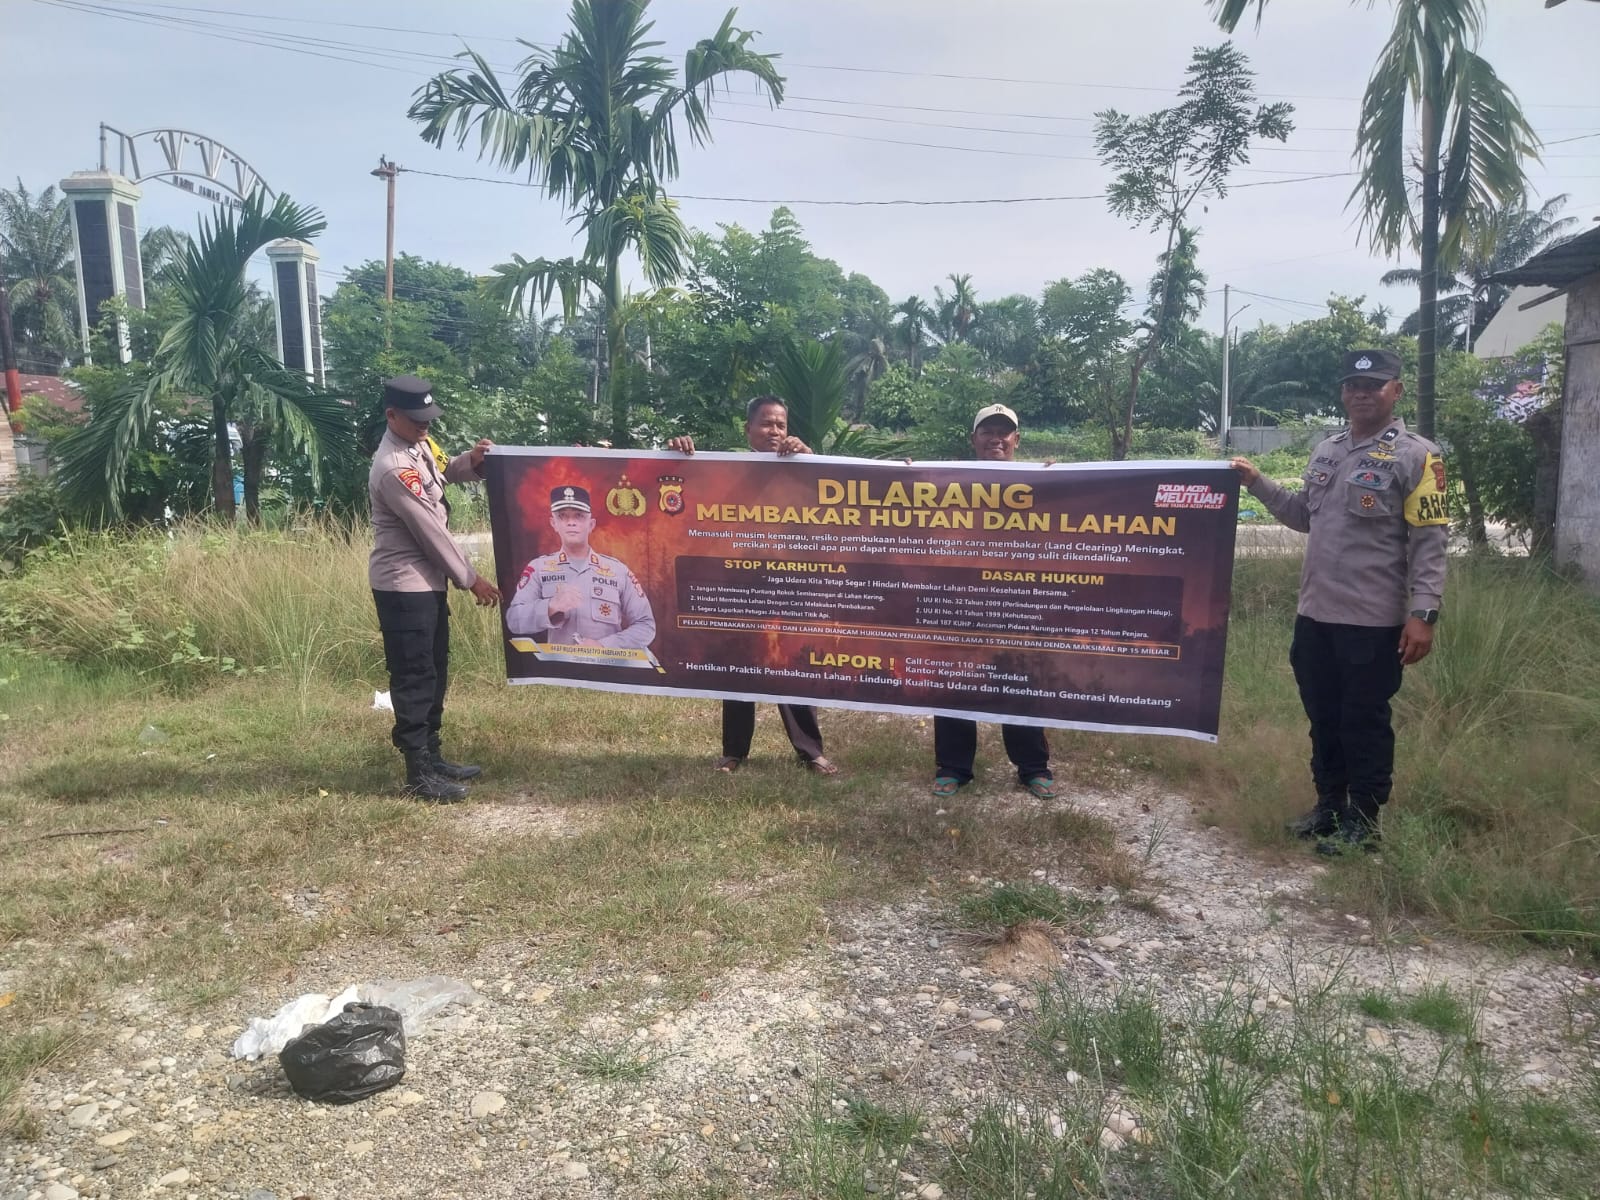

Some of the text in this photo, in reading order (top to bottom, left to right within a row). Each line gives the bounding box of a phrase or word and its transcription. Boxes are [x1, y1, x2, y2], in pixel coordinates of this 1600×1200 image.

[1359, 459, 1394, 470] POLRI
[818, 478, 1034, 510] DILARANG
[1157, 484, 1208, 493] POLDA ACEH
[1154, 492, 1225, 504] MEUTUAH
[696, 503, 1177, 536] MEMBAKAR HUTAN DAN LAHAN
[688, 528, 733, 538] Memasuki
[736, 530, 764, 539] musim
[767, 531, 808, 543] kemarau,
[811, 533, 838, 542] resiko
[841, 534, 895, 545] pembukaan
[898, 535, 923, 544] lahan
[926, 536, 961, 547] dengan
[987, 538, 1040, 549] membakar
[1044, 541, 1071, 552] (Land
[1075, 542, 1121, 554] Clearing)
[1125, 544, 1184, 556] Meningkat,
[732, 539, 1131, 562] percikan api sekecil apa pun dapat memicu kebakaran besar yang sulit dikendalikan.
[724, 559, 847, 574] STOP KARHUTLA
[541, 575, 565, 583] MUGHI
[592, 577, 617, 587] POLRI
[981, 570, 1104, 585] DASAR HUKUM
[767, 575, 783, 584] Jaga
[785, 575, 806, 583] Udara
[824, 577, 843, 587] Tetap
[845, 578, 866, 588] Segar
[872, 580, 899, 588] Hindari
[901, 581, 941, 590] Membakar
[943, 584, 966, 592] Lahan
[967, 585, 988, 593] Demi
[990, 586, 1030, 595] Kesehatan
[1032, 588, 1068, 597] Bersama.
[942, 607, 953, 615] No.
[1002, 600, 1047, 610] (Perlindungan
[1063, 603, 1103, 613] Pengelolaan
[1105, 605, 1145, 615] Lingkungan
[1147, 608, 1172, 617] Hidup).
[922, 617, 939, 625] Pasal
[952, 619, 971, 627] KUHP
[976, 620, 1006, 629] Ancaman
[1007, 622, 1029, 630] Pidana
[1031, 624, 1062, 633] Kurungan
[1064, 626, 1088, 635] Hingga
[1100, 628, 1120, 636] Tahun
[1122, 629, 1149, 639] Penjara.
[682, 618, 708, 626] PELAKU
[709, 619, 755, 629] PEMBAKARAN
[757, 622, 780, 630] HUTAN
[799, 625, 823, 633] LAHAN
[824, 626, 858, 635] DIANCAM
[860, 629, 897, 637] HUKUMAN
[899, 631, 930, 640] PENJARA
[933, 633, 959, 642] PALING
[961, 635, 982, 643] LAMA
[995, 637, 1022, 646] TAHUN
[1024, 639, 1041, 647] DAN
[1043, 640, 1070, 649] DENDA
[1072, 642, 1115, 652] MAKSIMAL
[1140, 647, 1169, 655] MILIAR
[809, 651, 882, 670] LAPOR
[905, 656, 996, 670] Call Center 110 atau
[905, 665, 1028, 681] Kantor Kepolisian Terdekat
[686, 661, 1171, 708] Hentikan Praktik Pembakaran Lahan Lindungi Kualitas Udara dan Kesehatan Generasi Mendatang
